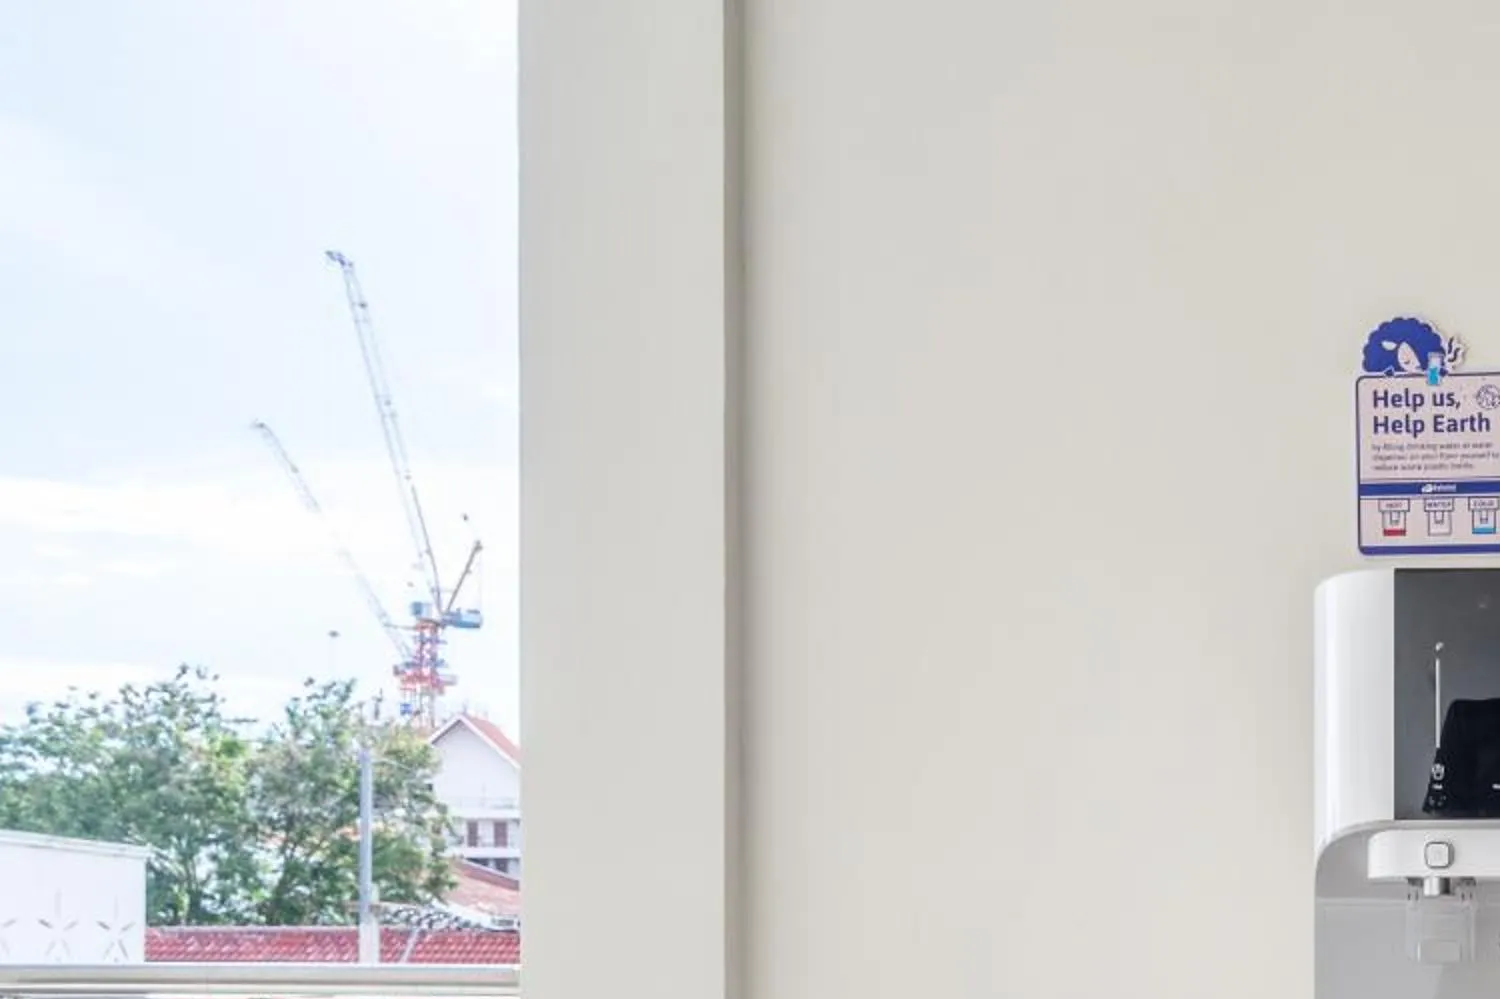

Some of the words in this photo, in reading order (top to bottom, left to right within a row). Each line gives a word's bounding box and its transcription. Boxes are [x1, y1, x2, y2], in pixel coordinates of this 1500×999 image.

[1372, 388, 1425, 412] Help
[1432, 391, 1461, 410] us,
[1372, 413, 1425, 438] Help
[1433, 412, 1491, 433] Earth
